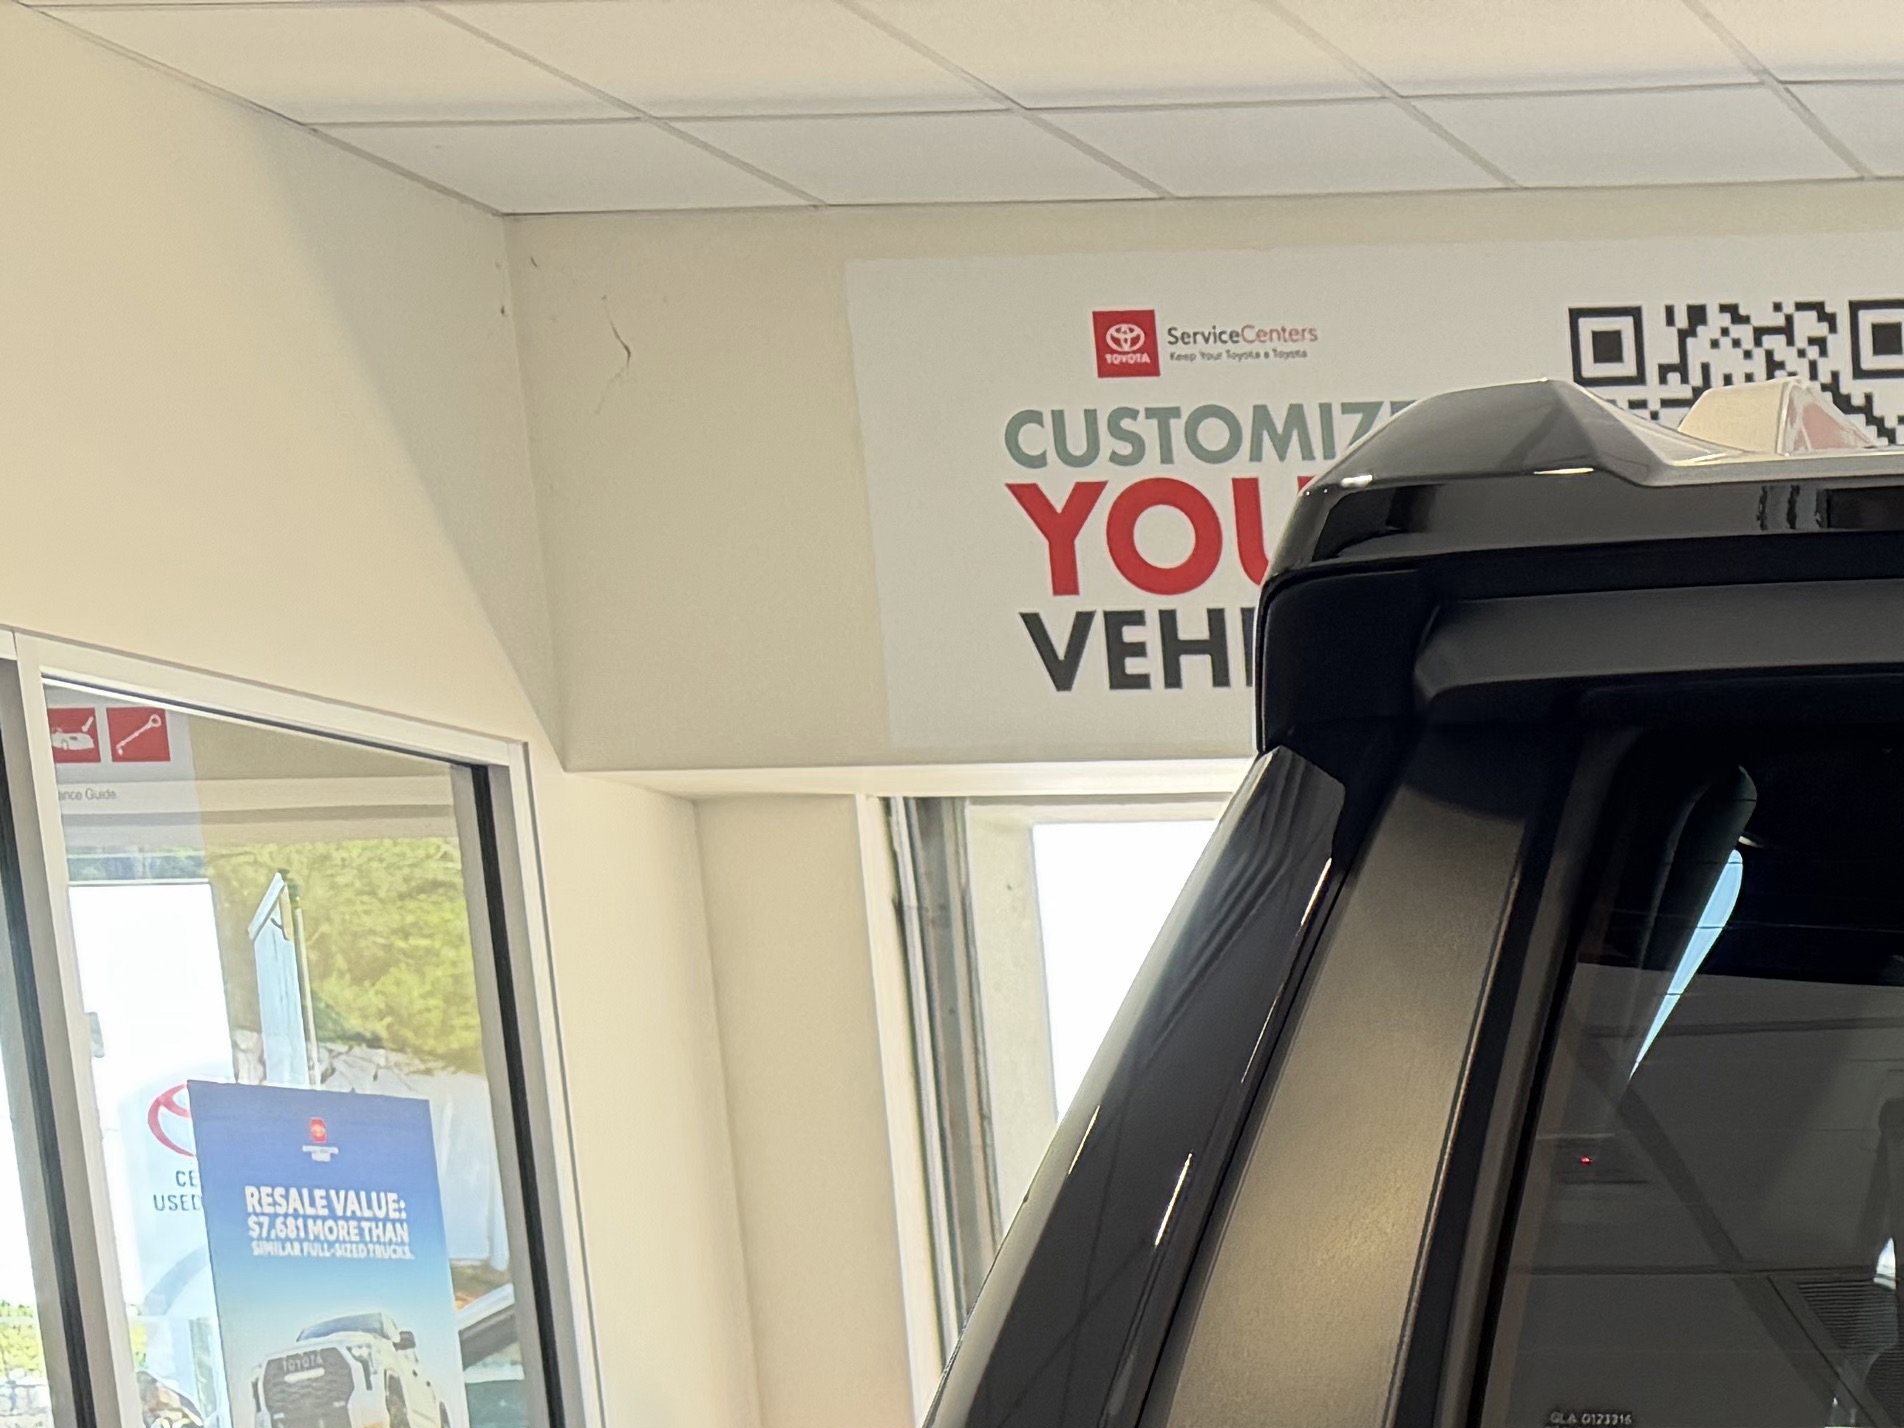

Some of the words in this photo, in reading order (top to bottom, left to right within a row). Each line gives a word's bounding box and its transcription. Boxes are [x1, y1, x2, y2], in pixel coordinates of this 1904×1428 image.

[1167, 324, 1318, 346] ServiceCenters
[1105, 353, 1151, 364] TOYOTA
[1170, 351, 1197, 362] Keep
[1199, 350, 1223, 361] Your
[1226, 349, 1261, 363] Toyota
[1272, 348, 1308, 361] Toyota
[1005, 400, 1418, 470] CUSTOMIZ
[245, 1185, 329, 1216] RESALE
[329, 1189, 407, 1220] VALUE:
[307, 1218, 360, 1242] MORE
[360, 1221, 410, 1243] THAN
[252, 1241, 301, 1256] SIMILAR
[303, 1242, 368, 1259] FULL-SIZED
[369, 1245, 415, 1260] TRUCKS.
